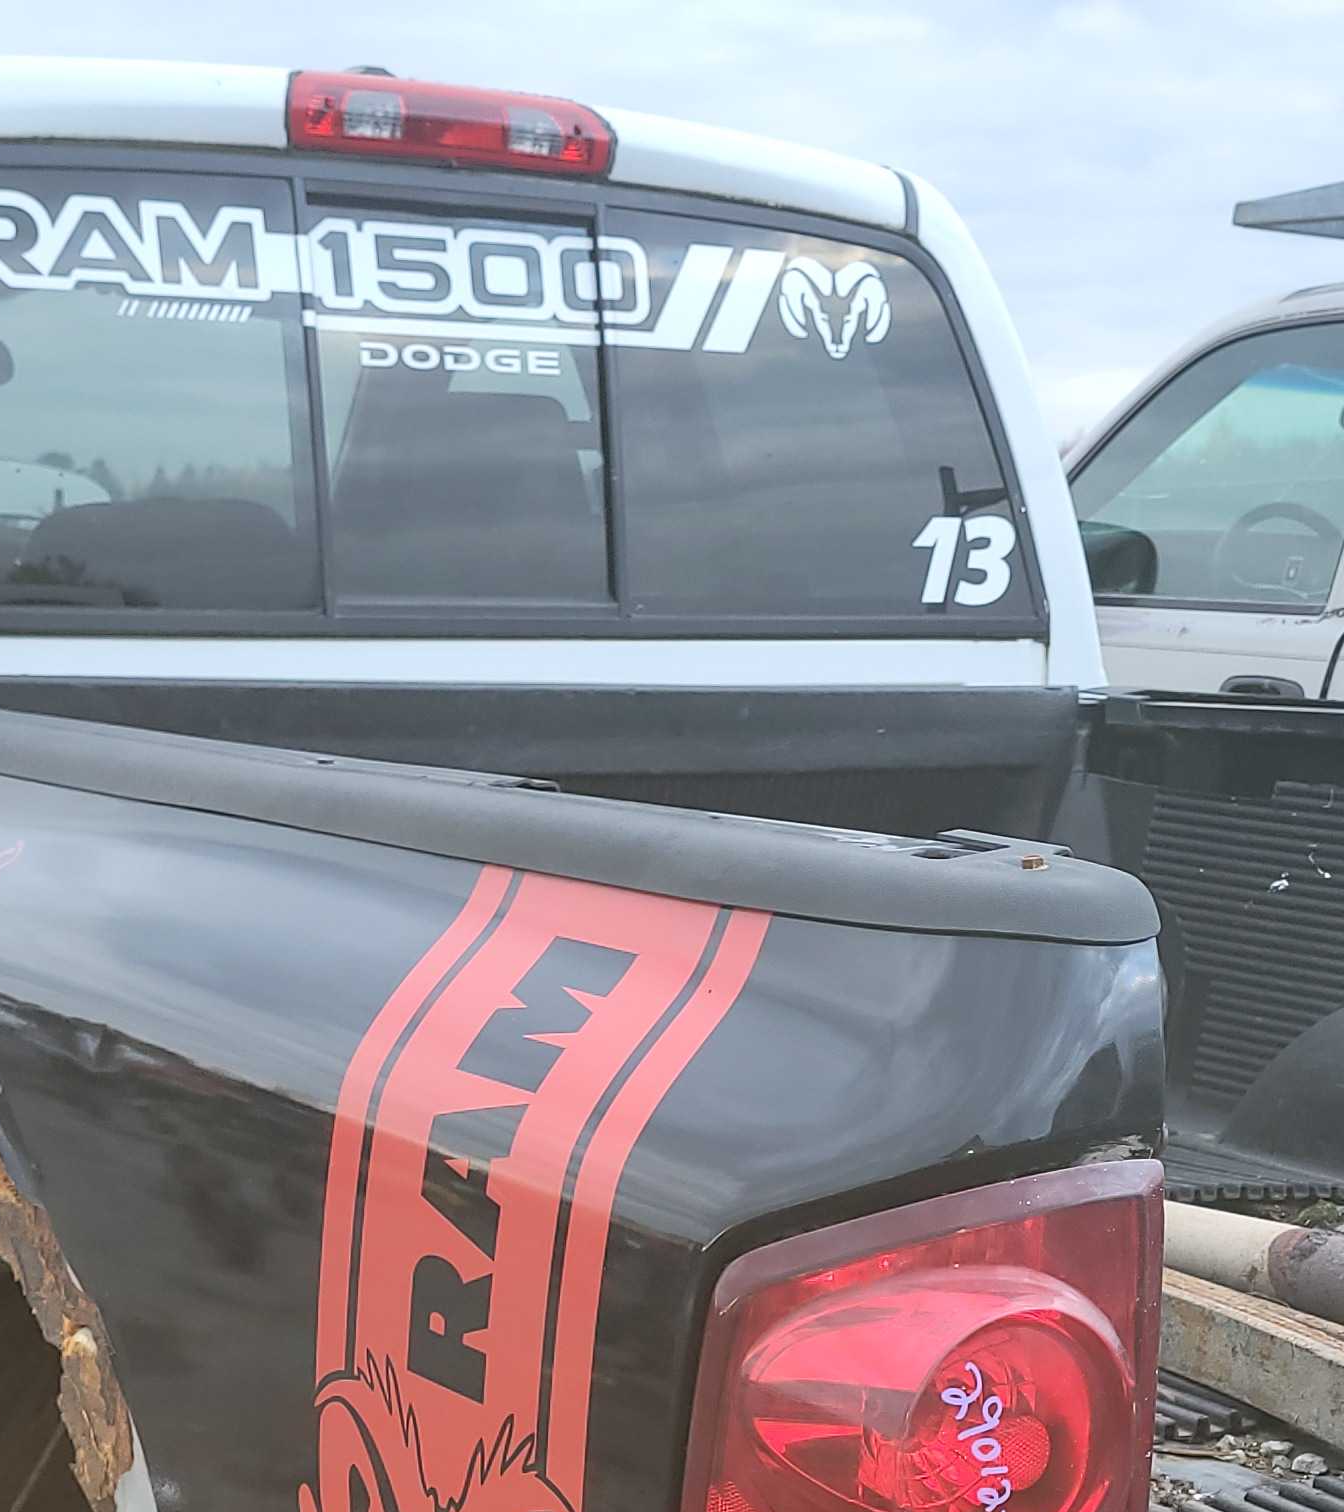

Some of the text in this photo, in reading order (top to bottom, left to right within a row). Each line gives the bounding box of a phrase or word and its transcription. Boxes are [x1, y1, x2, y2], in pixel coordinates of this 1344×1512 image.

[308, 216, 653, 326] 1500
[359, 341, 561, 376] DODGE
[911, 515, 1015, 607] 13
[406, 935, 640, 1405] RAM
